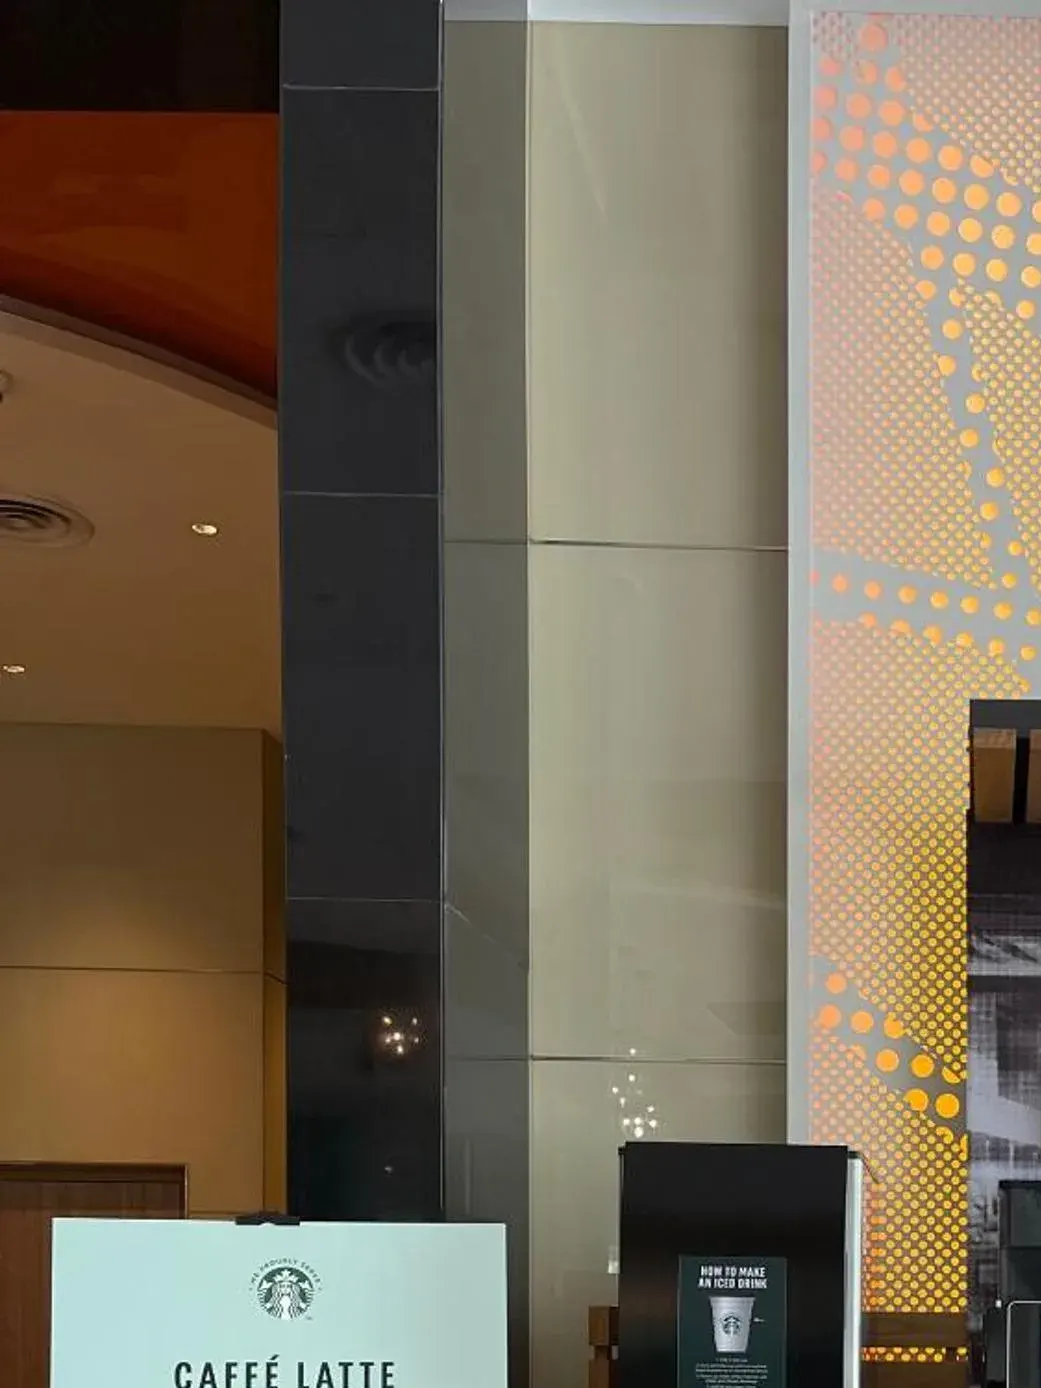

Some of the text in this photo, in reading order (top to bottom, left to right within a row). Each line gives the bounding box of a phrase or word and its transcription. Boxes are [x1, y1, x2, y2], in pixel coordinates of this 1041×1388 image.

[700, 1265, 766, 1278] HOW TO MAKE
[698, 1278, 767, 1289] AN ICED DRINK
